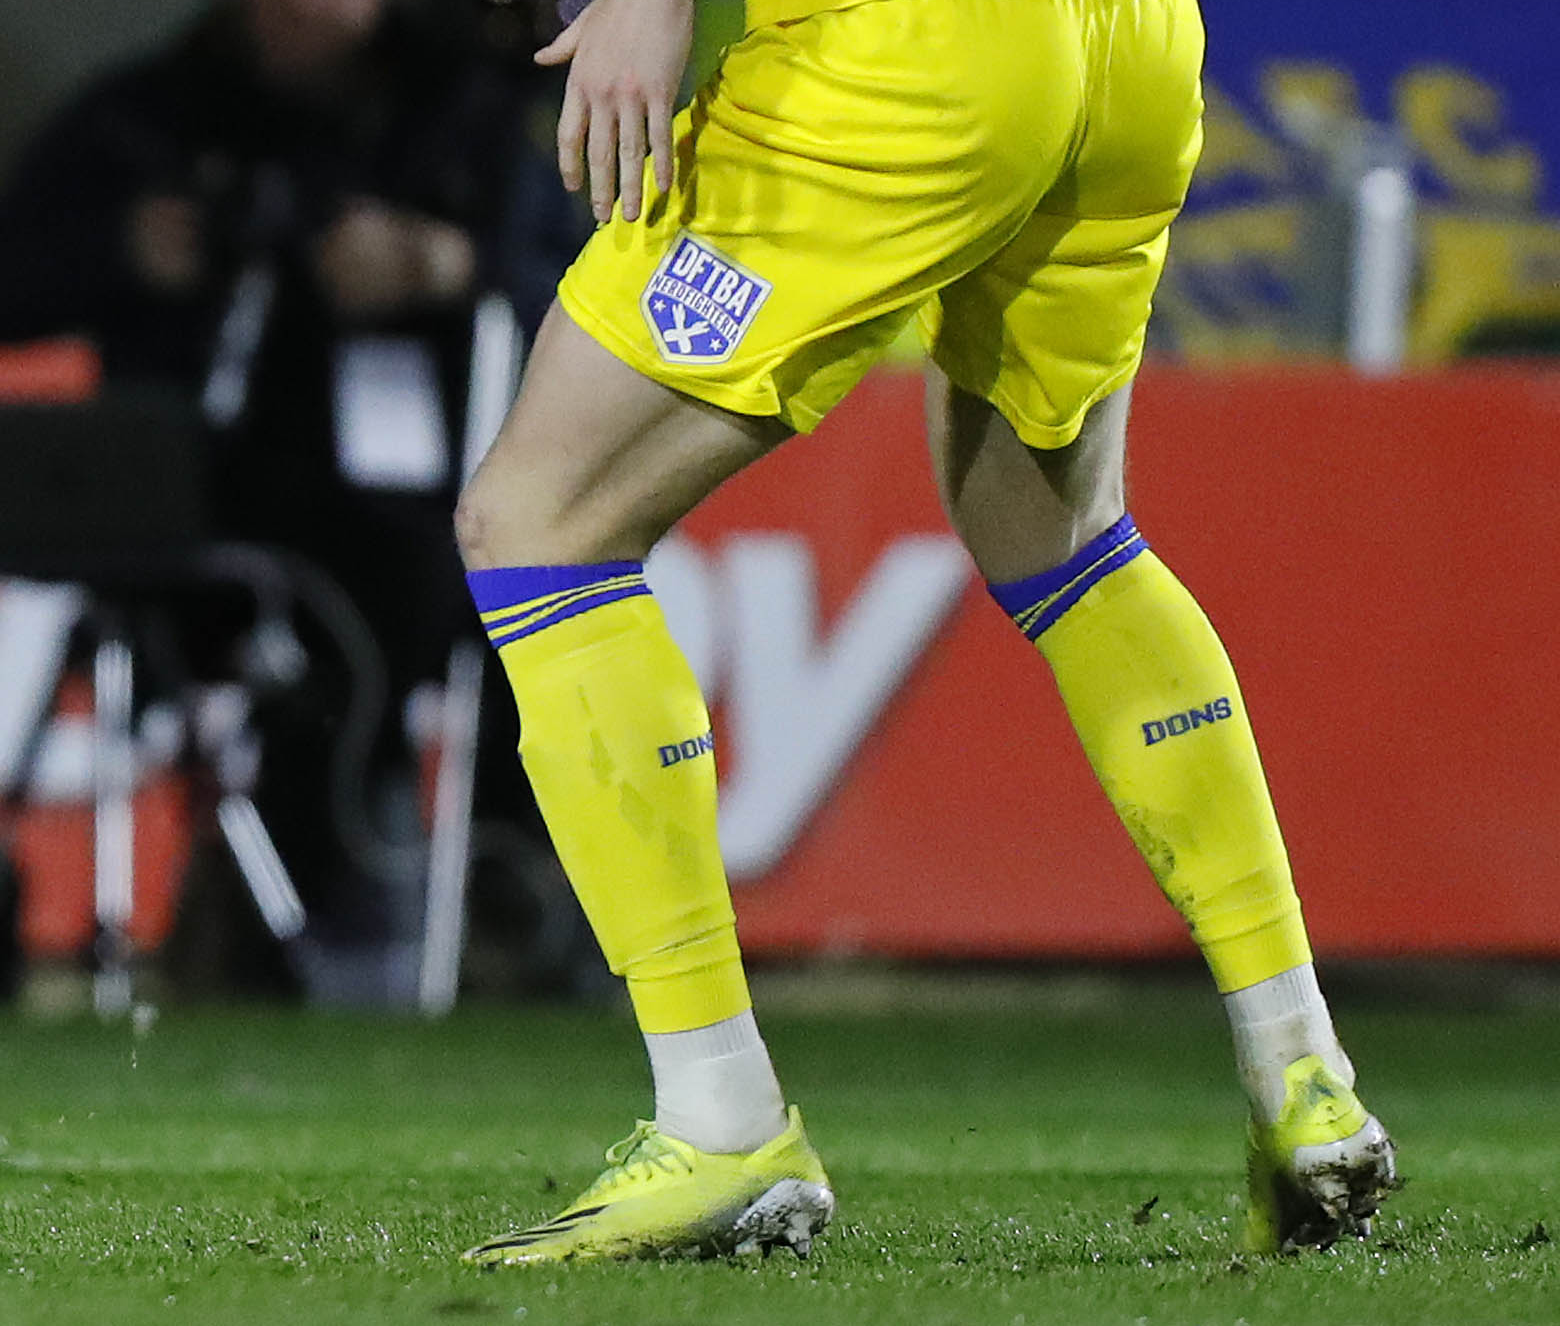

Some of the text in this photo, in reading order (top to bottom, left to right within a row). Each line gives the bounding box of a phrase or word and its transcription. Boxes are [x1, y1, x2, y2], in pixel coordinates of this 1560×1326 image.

[650, 273, 741, 345] NERDFIGHTERIA
[671, 241, 755, 318] DFTBA
[1141, 696, 1233, 747] DONS
